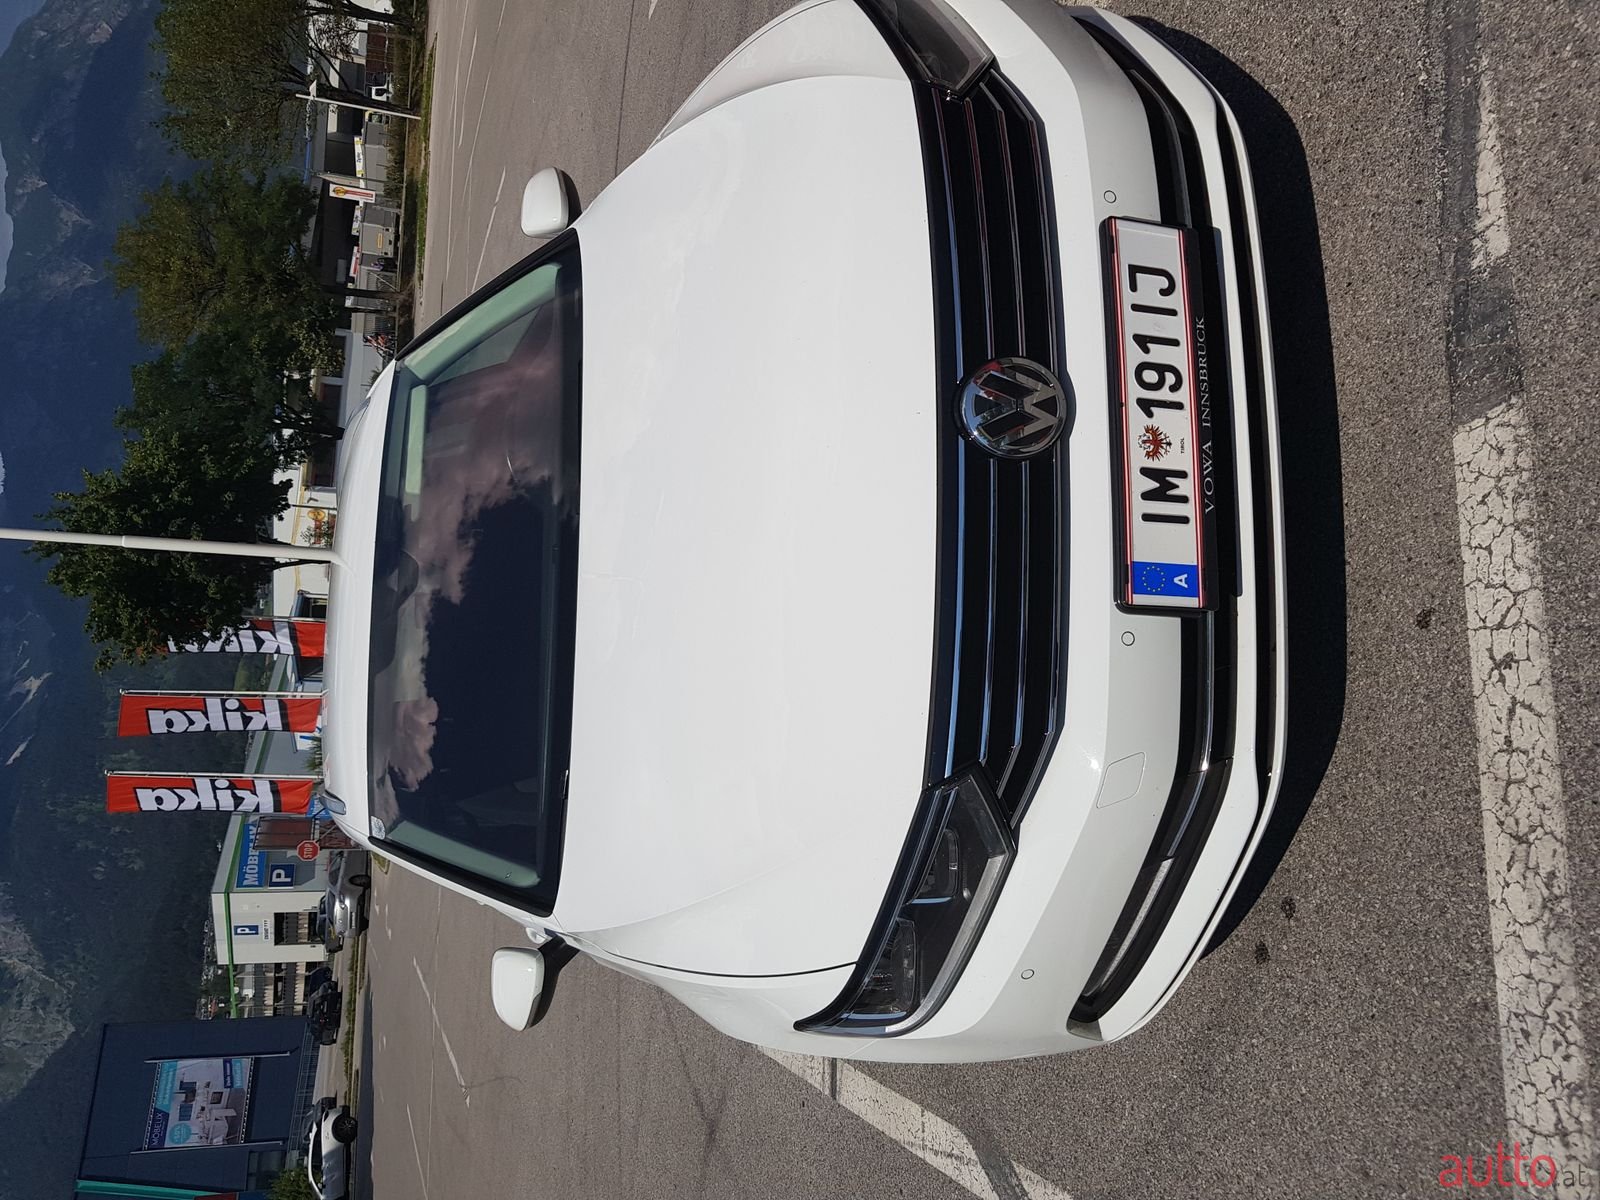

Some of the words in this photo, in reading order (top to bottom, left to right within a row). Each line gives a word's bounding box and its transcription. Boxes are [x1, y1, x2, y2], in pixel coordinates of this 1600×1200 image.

[1194, 316, 1214, 428] INNSBRUCK
[1139, 466, 1191, 525] IM
[1201, 441, 1216, 515] VOWA
[1173, 572, 1189, 589] A
[303, 843, 313, 859] STOP
[272, 869, 292, 883] P
